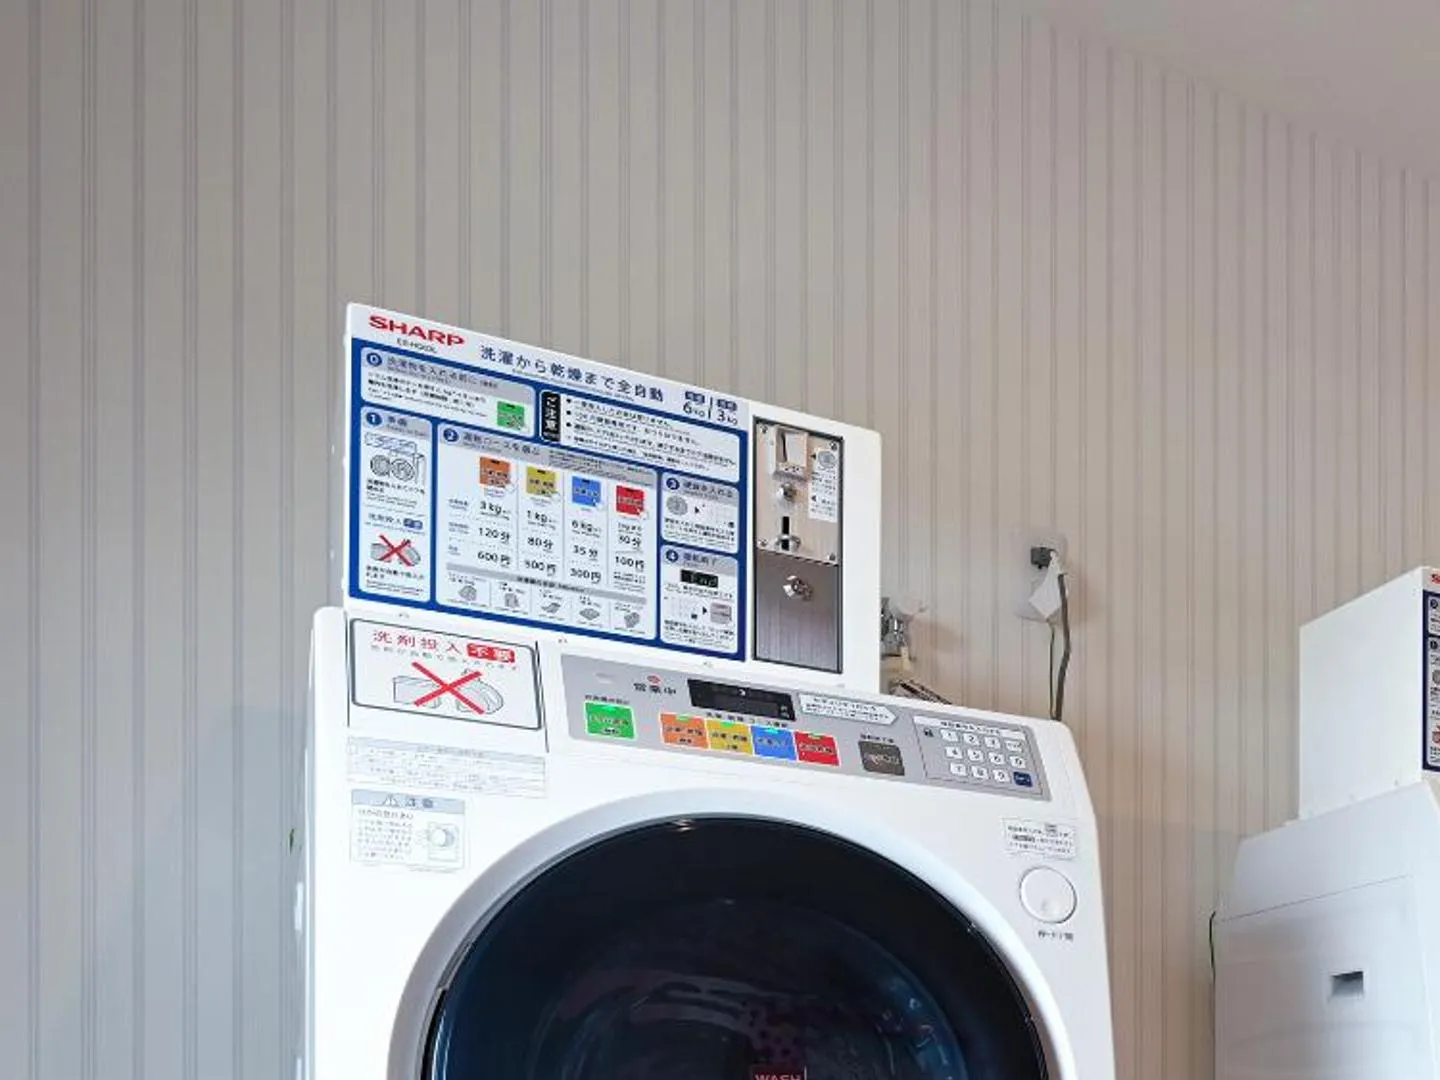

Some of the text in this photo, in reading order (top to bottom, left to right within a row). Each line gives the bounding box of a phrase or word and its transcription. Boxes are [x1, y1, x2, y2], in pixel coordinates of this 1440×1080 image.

[369, 316, 465, 346] SHARP
[481, 345, 664, 402] 洗濯から乾燥まで全自動
[373, 631, 461, 654] 洗剤投入
